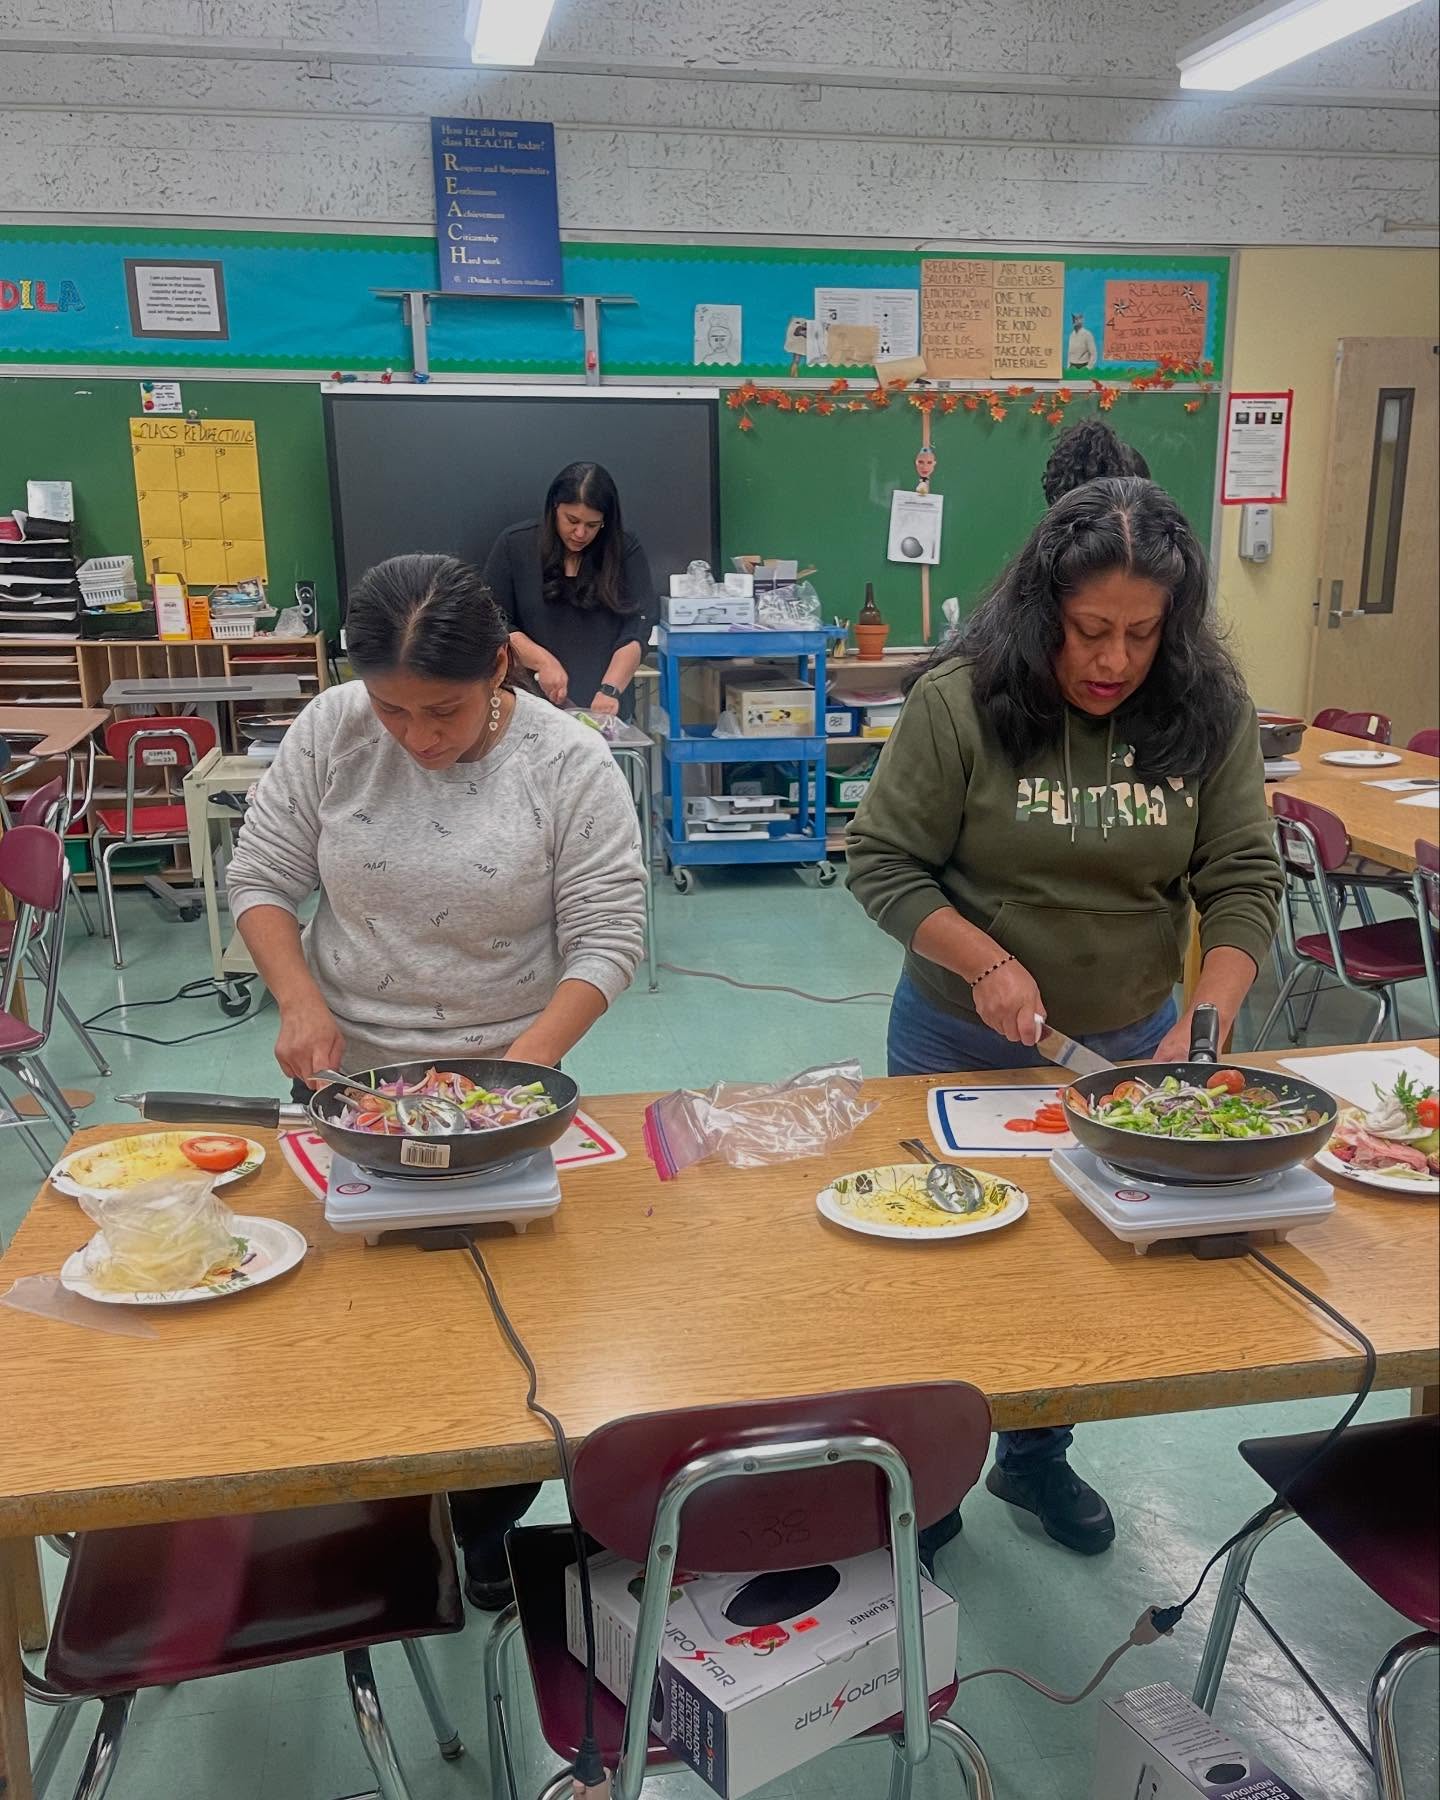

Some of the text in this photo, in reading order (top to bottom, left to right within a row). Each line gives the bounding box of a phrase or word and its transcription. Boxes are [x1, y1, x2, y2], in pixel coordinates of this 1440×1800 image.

[481, 128, 495, 136] did
[448, 223, 498, 243] Citizenship
[449, 246, 480, 264] Hard
[1023, 264, 1053, 275] CLASS
[995, 291, 1037, 304] ONE MIC
[1128, 283, 1180, 297] REACH
[996, 306, 1053, 318] RAISE HAND
[996, 319, 1038, 331] BE KIND
[996, 332, 1031, 344] LISTEN
[994, 346, 1017, 357] TAKE
[1019, 346, 1041, 357] CARE
[994, 359, 1049, 369] MATERIALS
[140, 422, 178, 439] CLASS
[1016, 777, 1168, 828] PUMA
[352, 808, 375, 824] love
[431, 821, 452, 838] love
[580, 816, 595, 840] love
[363, 860, 386, 872] love
[473, 862, 498, 879] love
[430, 908, 449, 927] love
[377, 973, 394, 992] love
[847, 1602, 890, 1626] BURNER
[678, 1684, 685, 1702] DE
[795, 1667, 901, 1730] EUROSTAR
[685, 1691, 693, 1751] ELECTRICO
[1220, 1779, 1275, 1800] INDIVIDUAL
